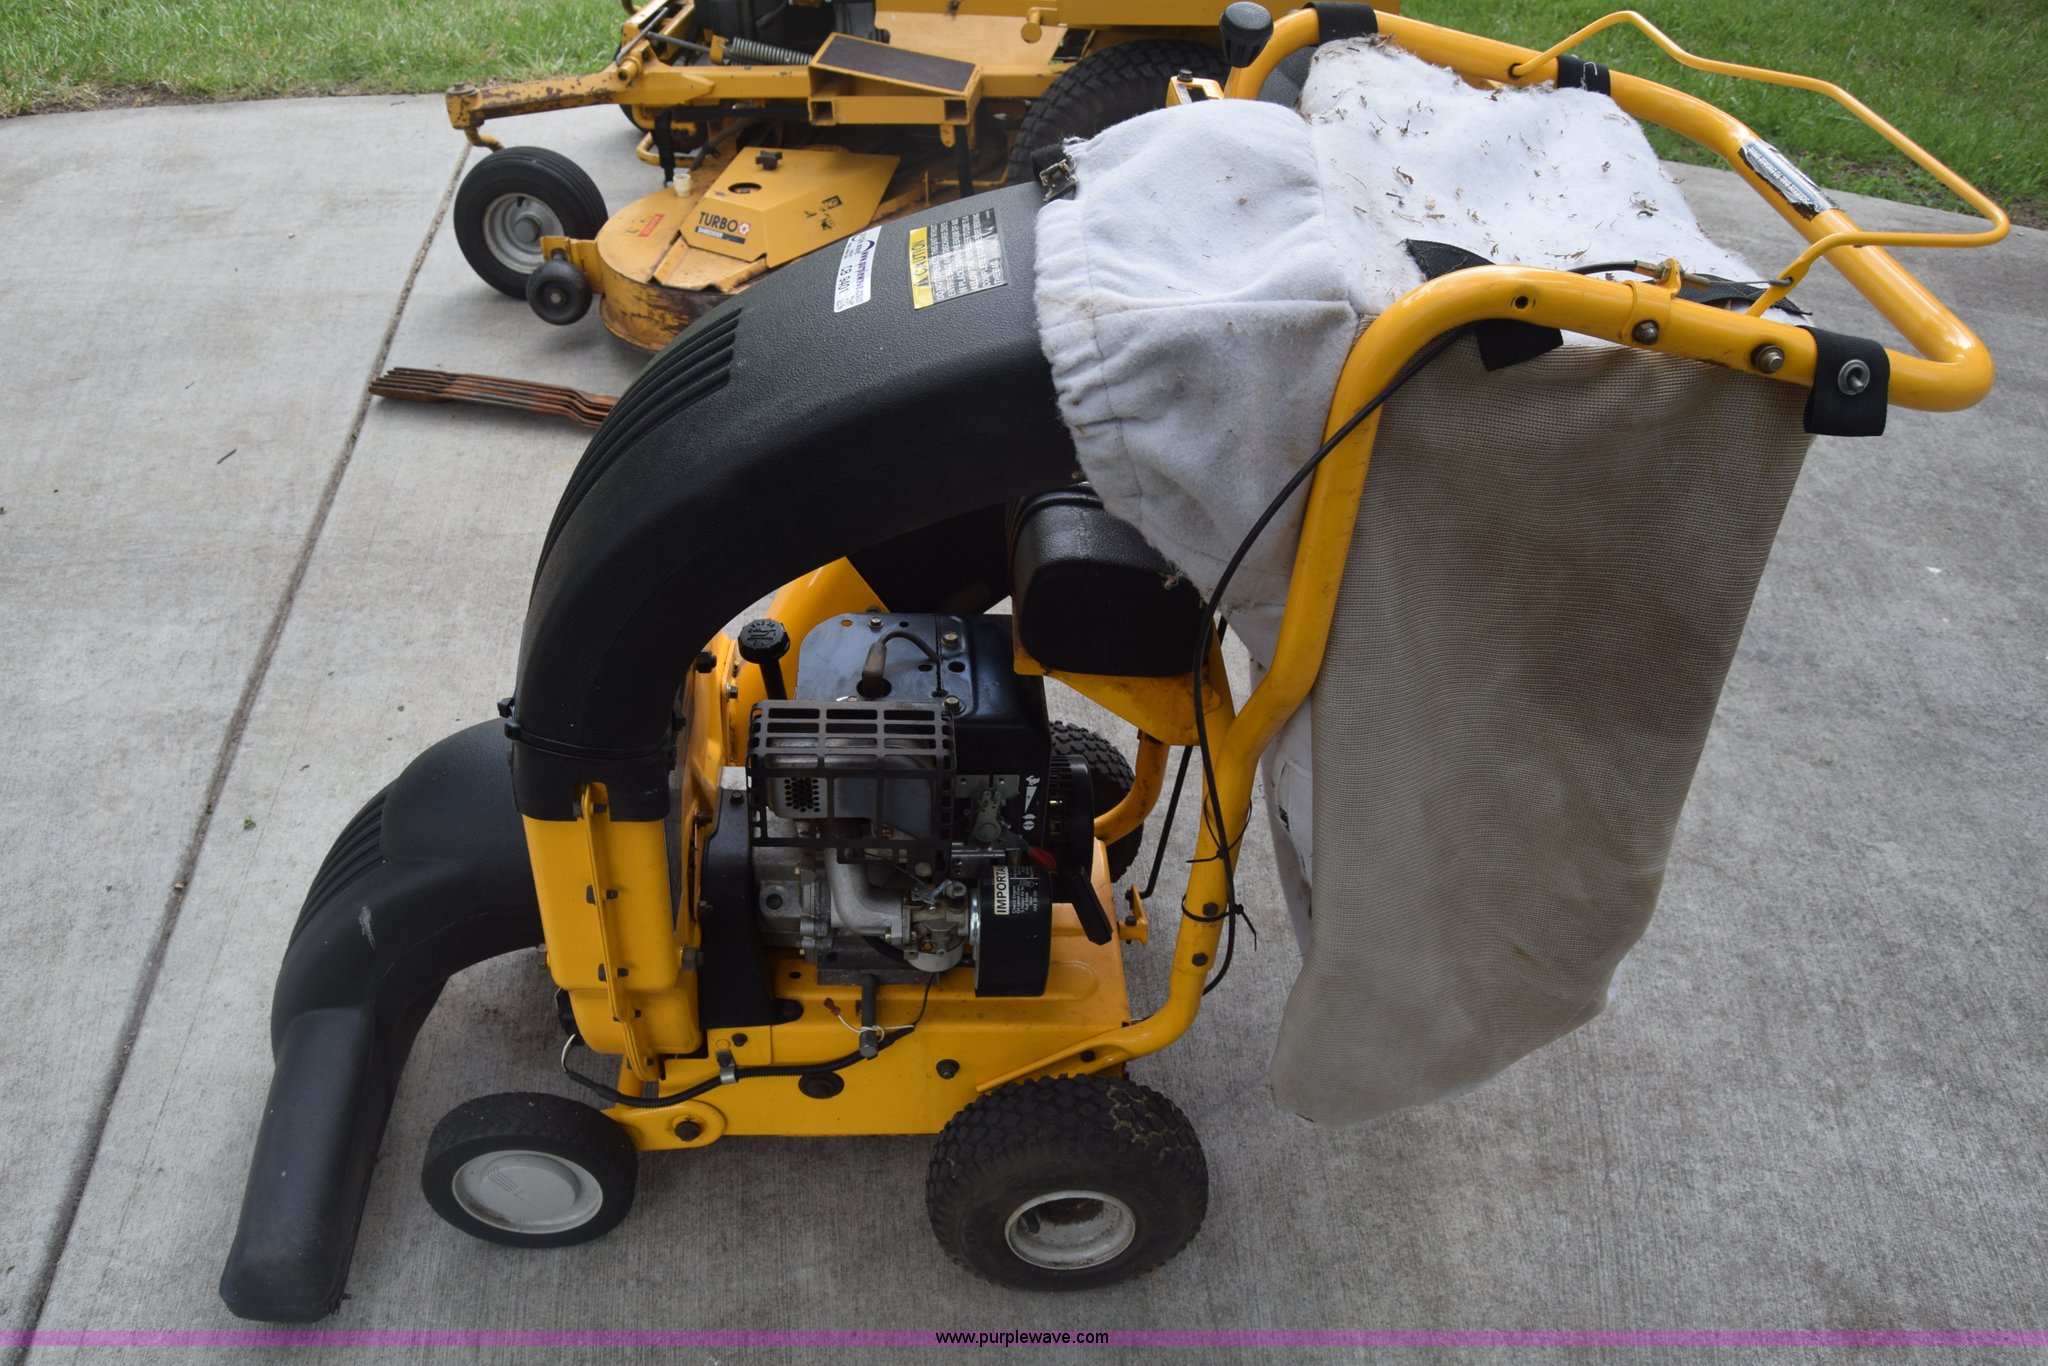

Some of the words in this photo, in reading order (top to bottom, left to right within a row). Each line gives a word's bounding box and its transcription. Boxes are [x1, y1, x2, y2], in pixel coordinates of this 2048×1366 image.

[699, 211, 738, 232] TURBO
[912, 240, 928, 276] CAUTION
[840, 265, 852, 276] CB
